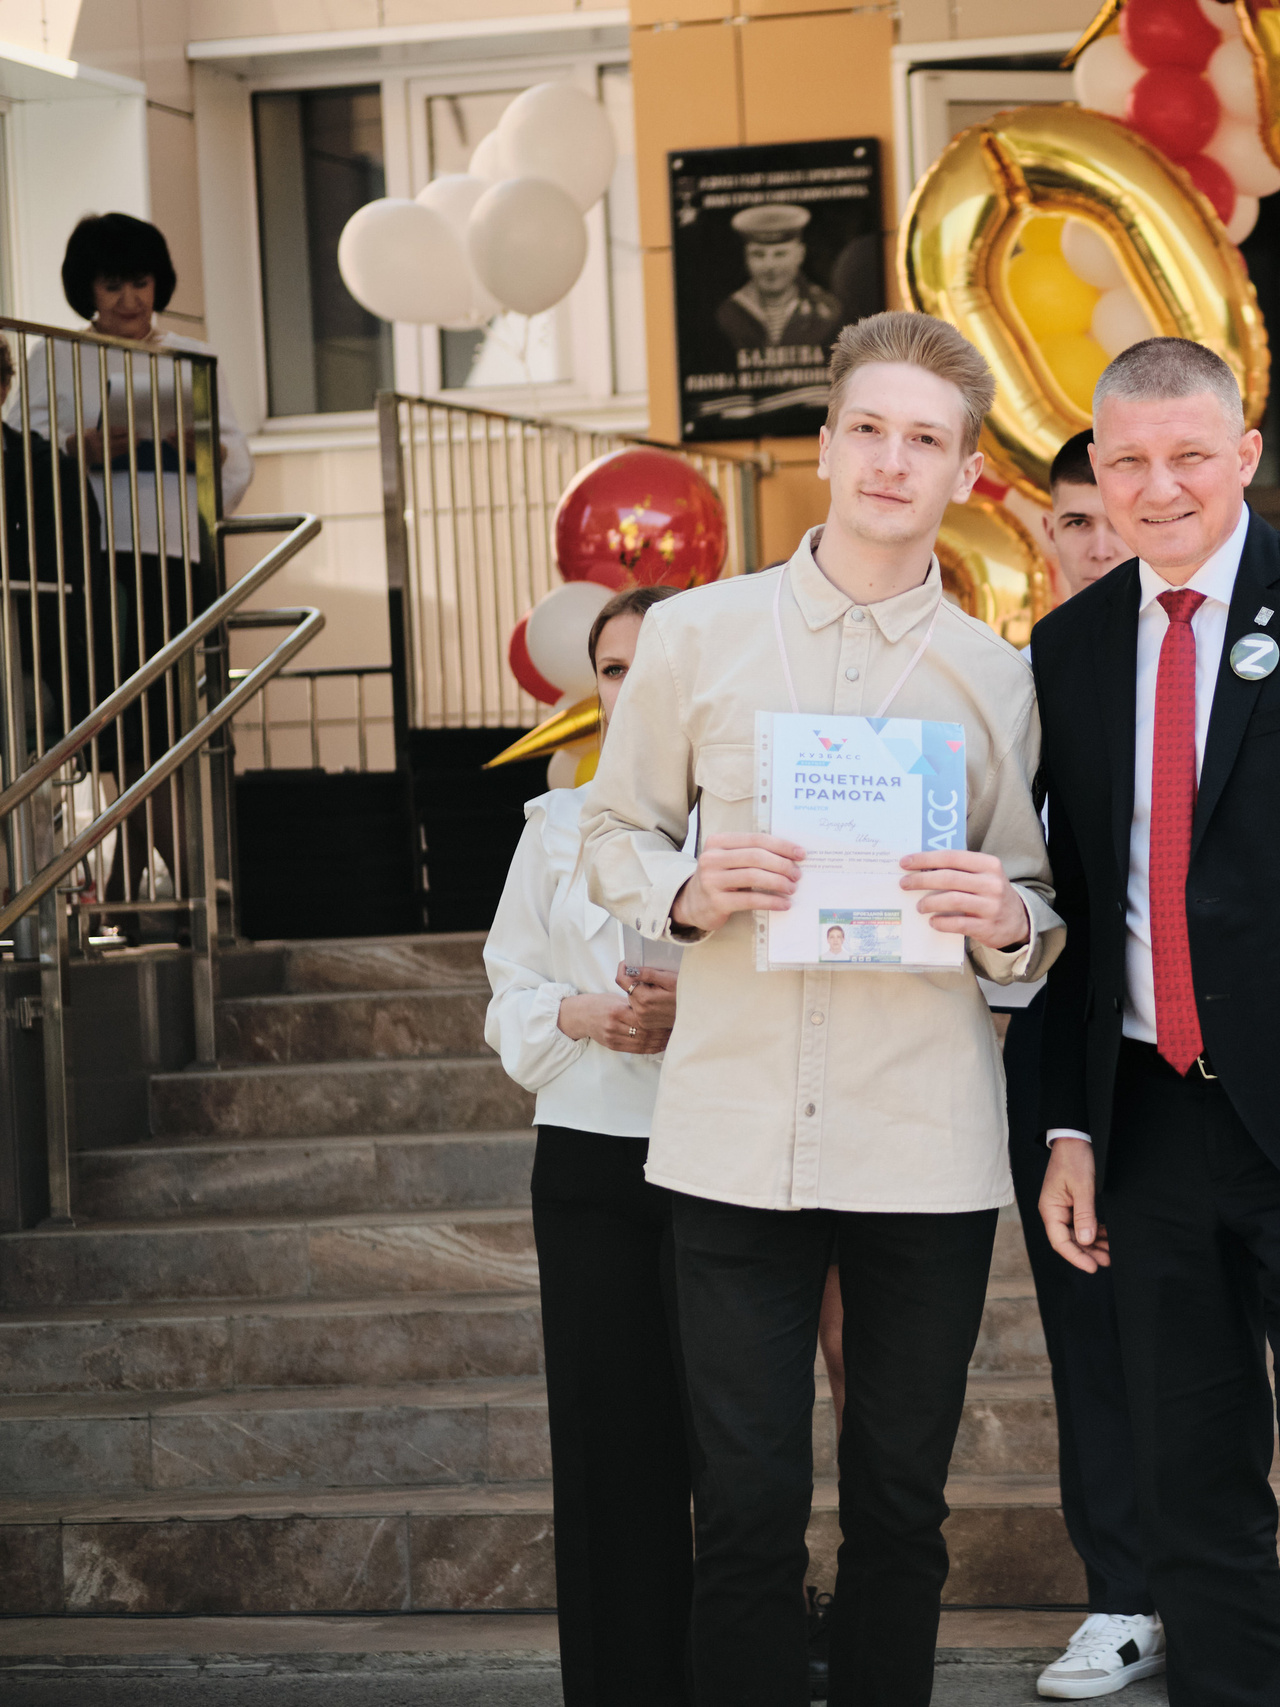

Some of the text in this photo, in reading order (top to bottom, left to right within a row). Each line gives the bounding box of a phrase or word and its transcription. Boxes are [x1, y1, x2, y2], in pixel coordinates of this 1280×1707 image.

[1236, 639, 1274, 674] Z
[799, 752, 862, 761] КУЗБАСС
[794, 772, 902, 787] ПОЧЕТНАЯ
[794, 788, 886, 802] ГРАМОТА
